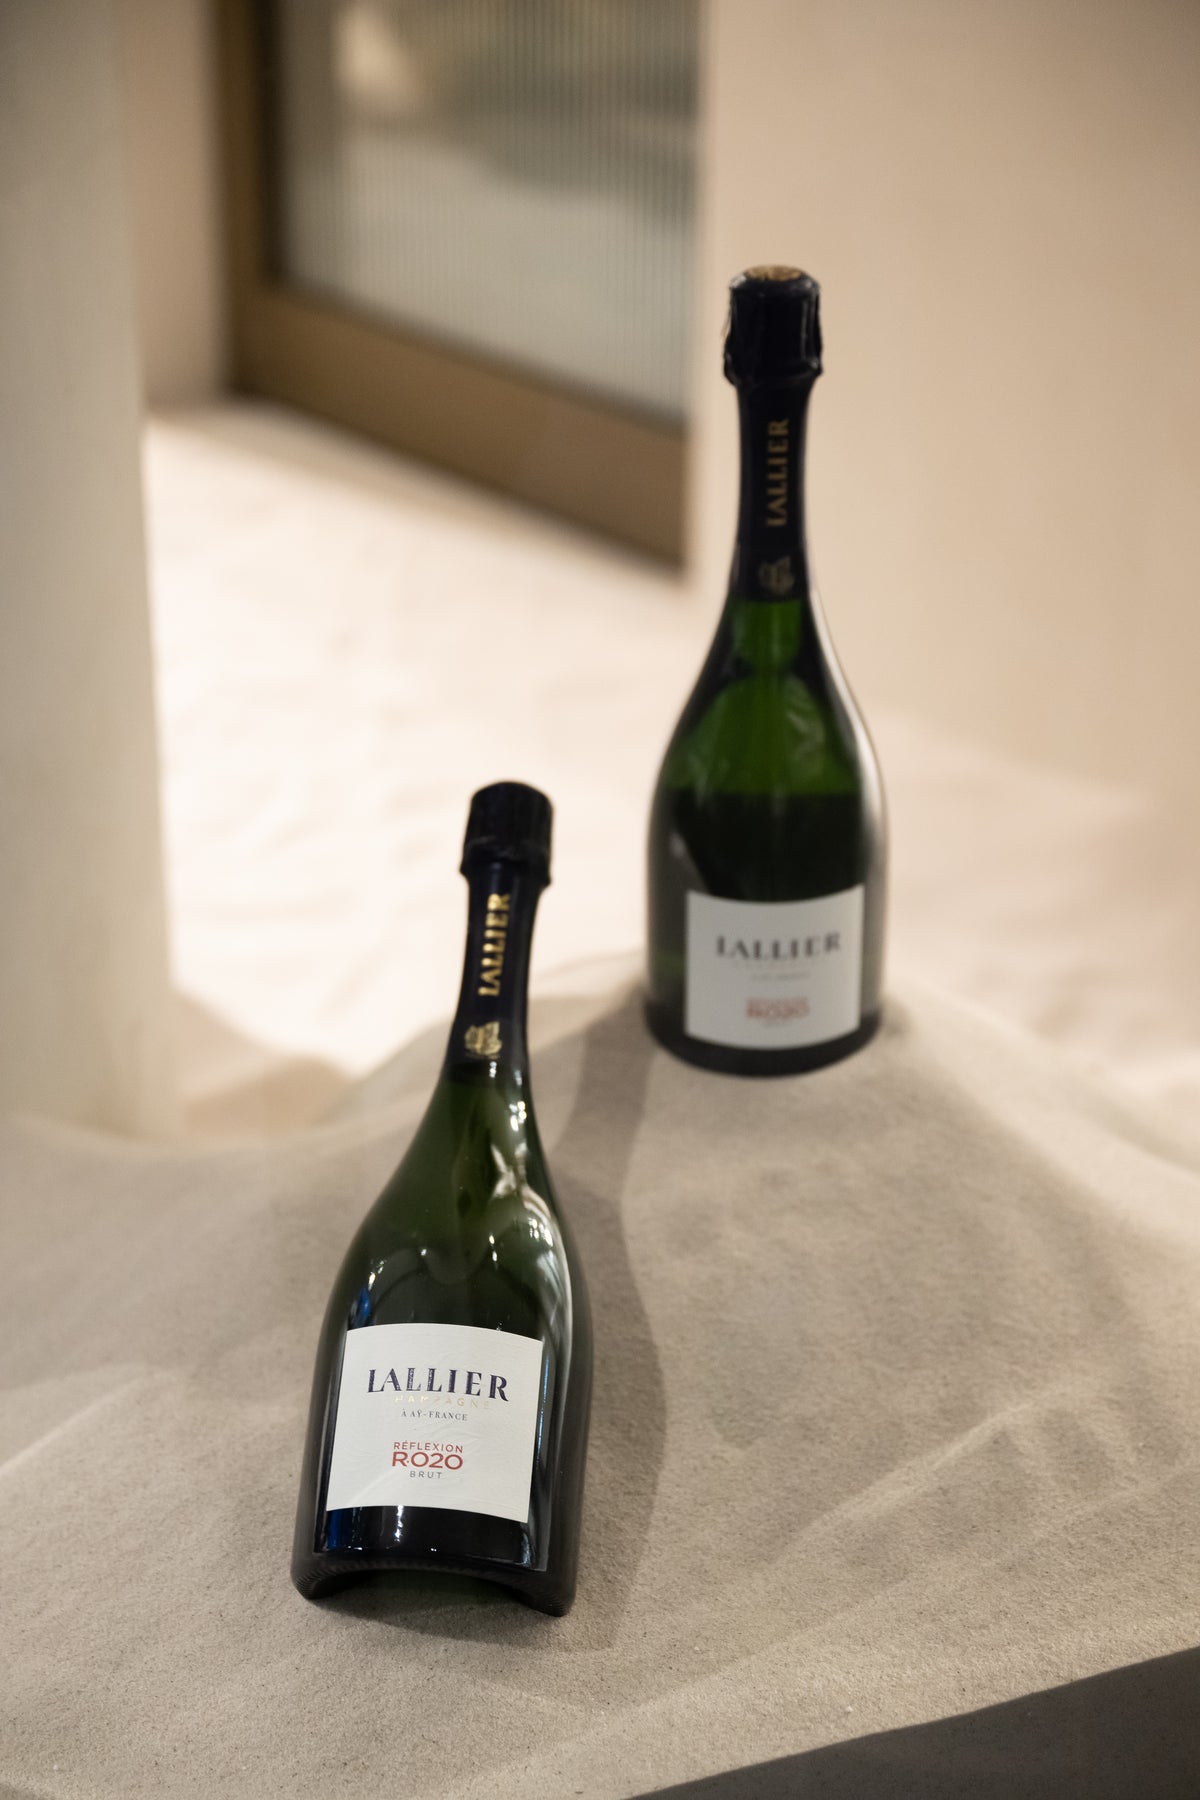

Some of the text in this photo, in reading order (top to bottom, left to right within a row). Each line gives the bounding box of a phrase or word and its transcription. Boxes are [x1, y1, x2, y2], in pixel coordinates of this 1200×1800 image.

[766, 417, 790, 527] LALLIER
[478, 893, 511, 996] LALLIER
[716, 932, 840, 960] LALLIER
[366, 1367, 509, 1402] LALLIER
[393, 1440, 463, 1453] RÉFLEXION
[409, 1471, 443, 1479] BRUT
